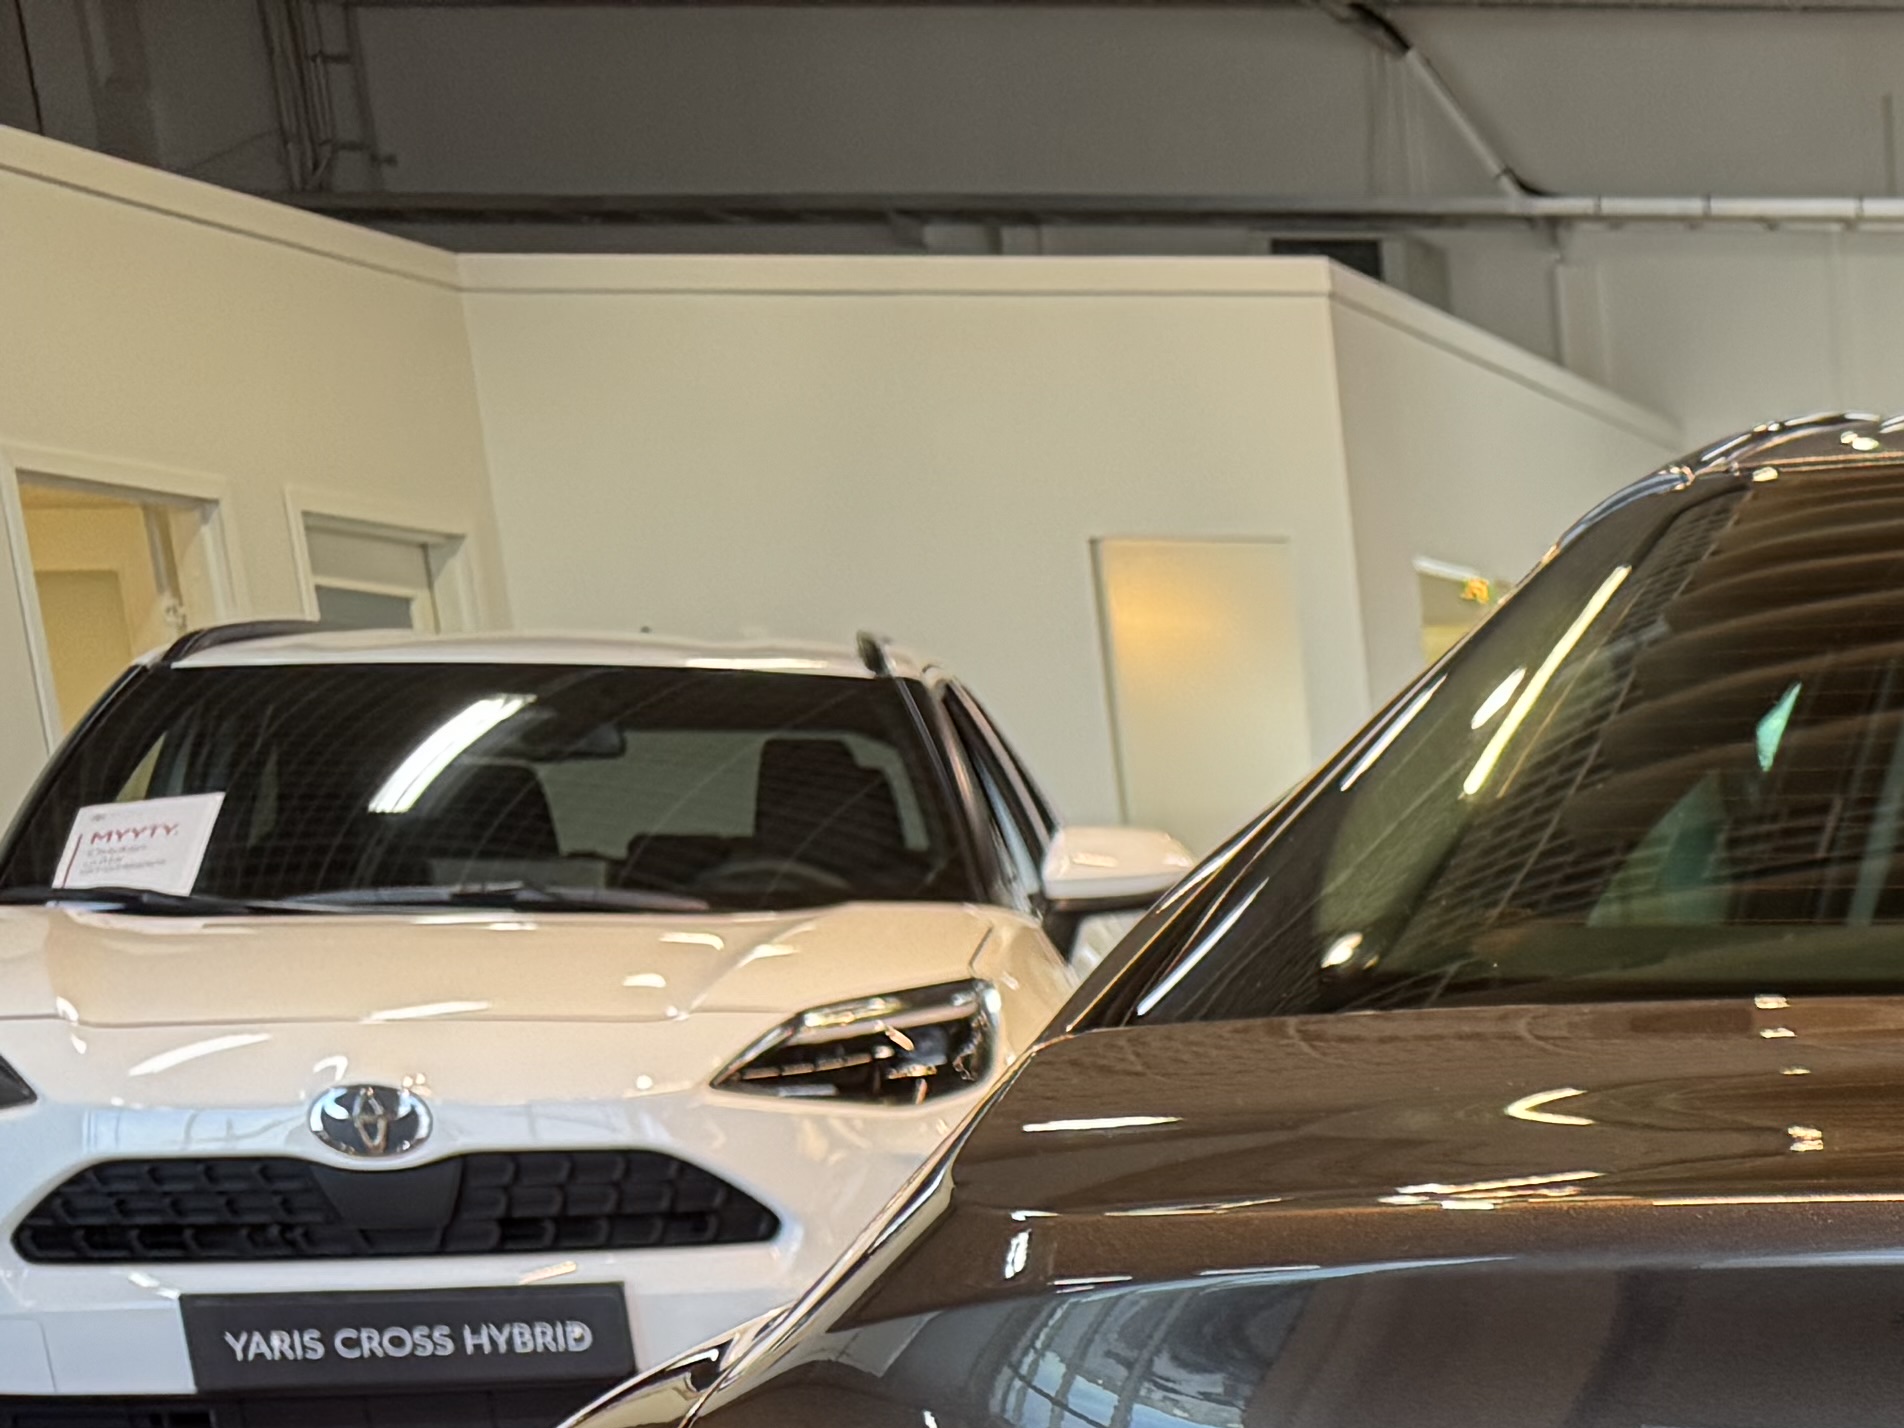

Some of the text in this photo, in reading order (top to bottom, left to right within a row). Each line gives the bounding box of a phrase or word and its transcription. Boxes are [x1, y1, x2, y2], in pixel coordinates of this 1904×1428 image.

[224, 1320, 594, 1361] YARIS CROSS HYBRID
